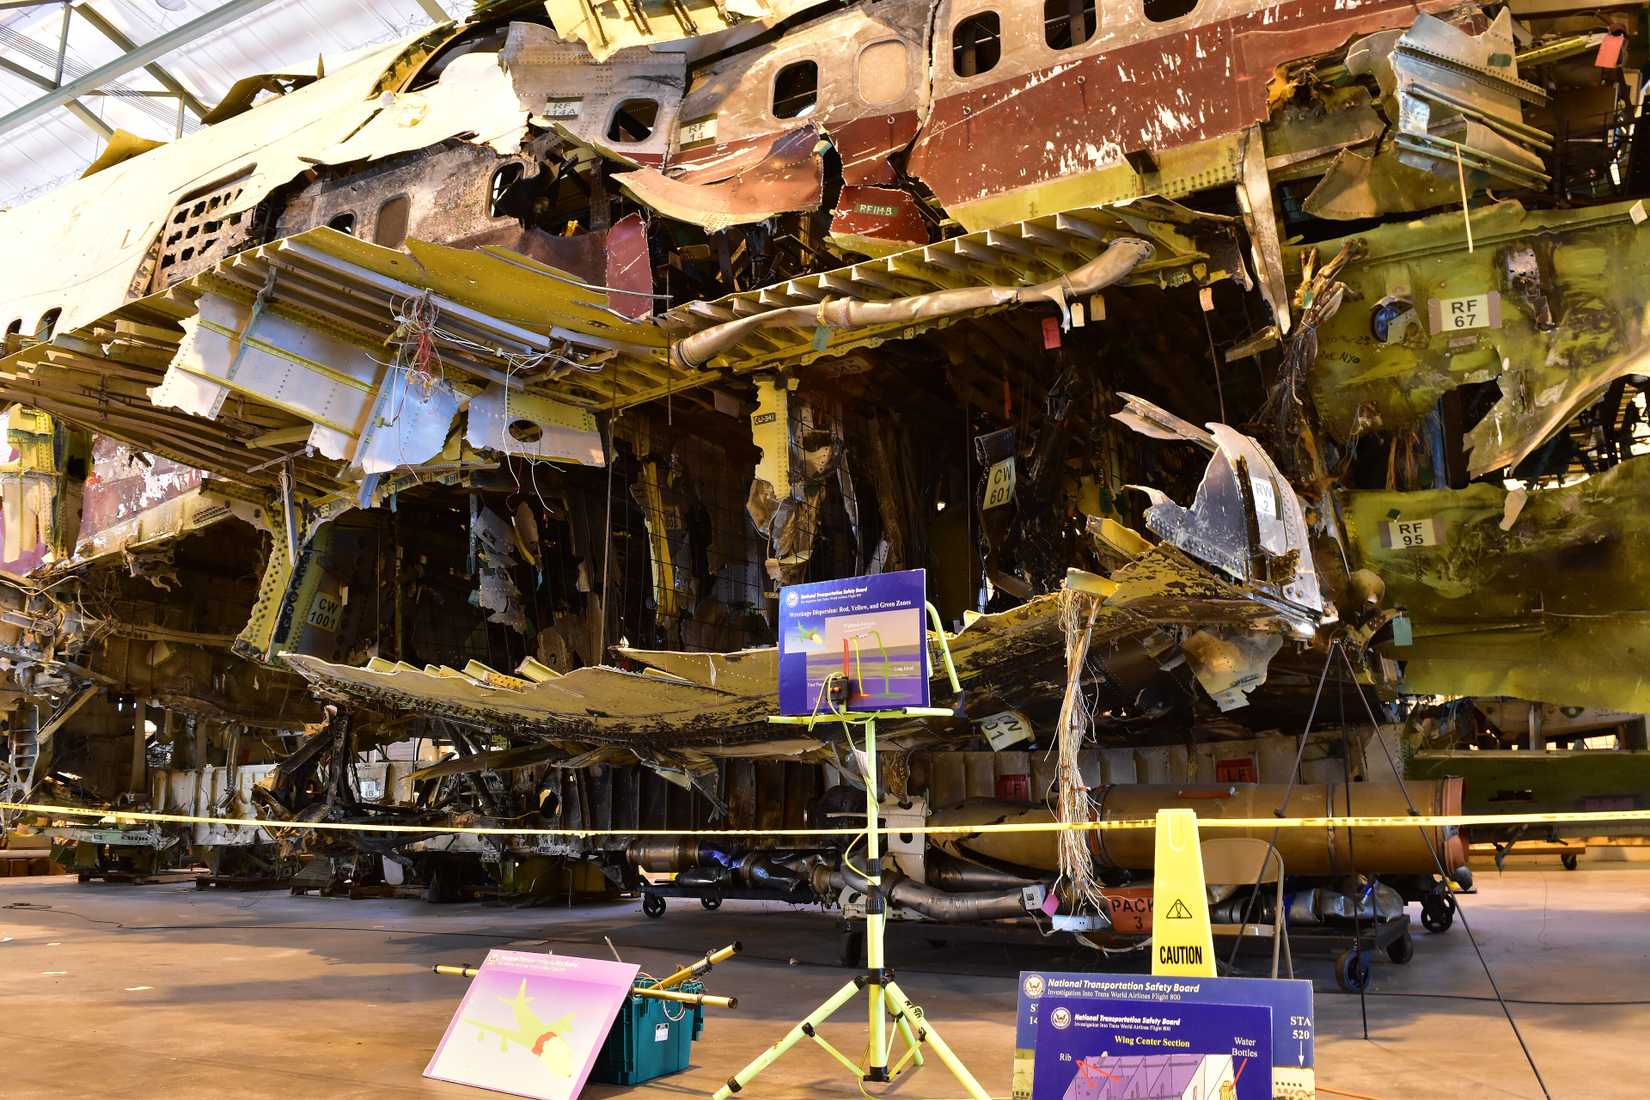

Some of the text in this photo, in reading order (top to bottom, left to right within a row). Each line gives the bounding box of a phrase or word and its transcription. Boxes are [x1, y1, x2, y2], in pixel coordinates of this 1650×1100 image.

[1451, 299, 1477, 314] RF
[1454, 314, 1476, 328] 67
[994, 464, 1011, 484] CW
[990, 487, 1009, 505] 601
[1255, 482, 1272, 498] RW
[1263, 500, 1270, 512] 2
[1399, 522, 1422, 534] RF
[1402, 535, 1424, 546] 95
[320, 598, 338, 613] CW
[310, 611, 335, 629] 1001
[1134, 916, 1143, 929] 3
[1160, 946, 1202, 964] CAUTION
[1048, 978, 1200, 993] National Transportation Safety Board
[1048, 989, 1081, 998] Investigation
[1152, 993, 1168, 1002] Flight
[1100, 1015, 1141, 1023] Transportation
[1142, 1017, 1161, 1025] Safety
[1162, 1018, 1180, 1026] Board
[1290, 1016, 1311, 1026] STA
[1115, 1035, 1190, 1048] Wing Center Section
[1234, 1037, 1256, 1046] Water
[1292, 1030, 1310, 1040] 520
[1059, 1052, 1072, 1062] Rib
[1232, 1048, 1258, 1057] Bottles
